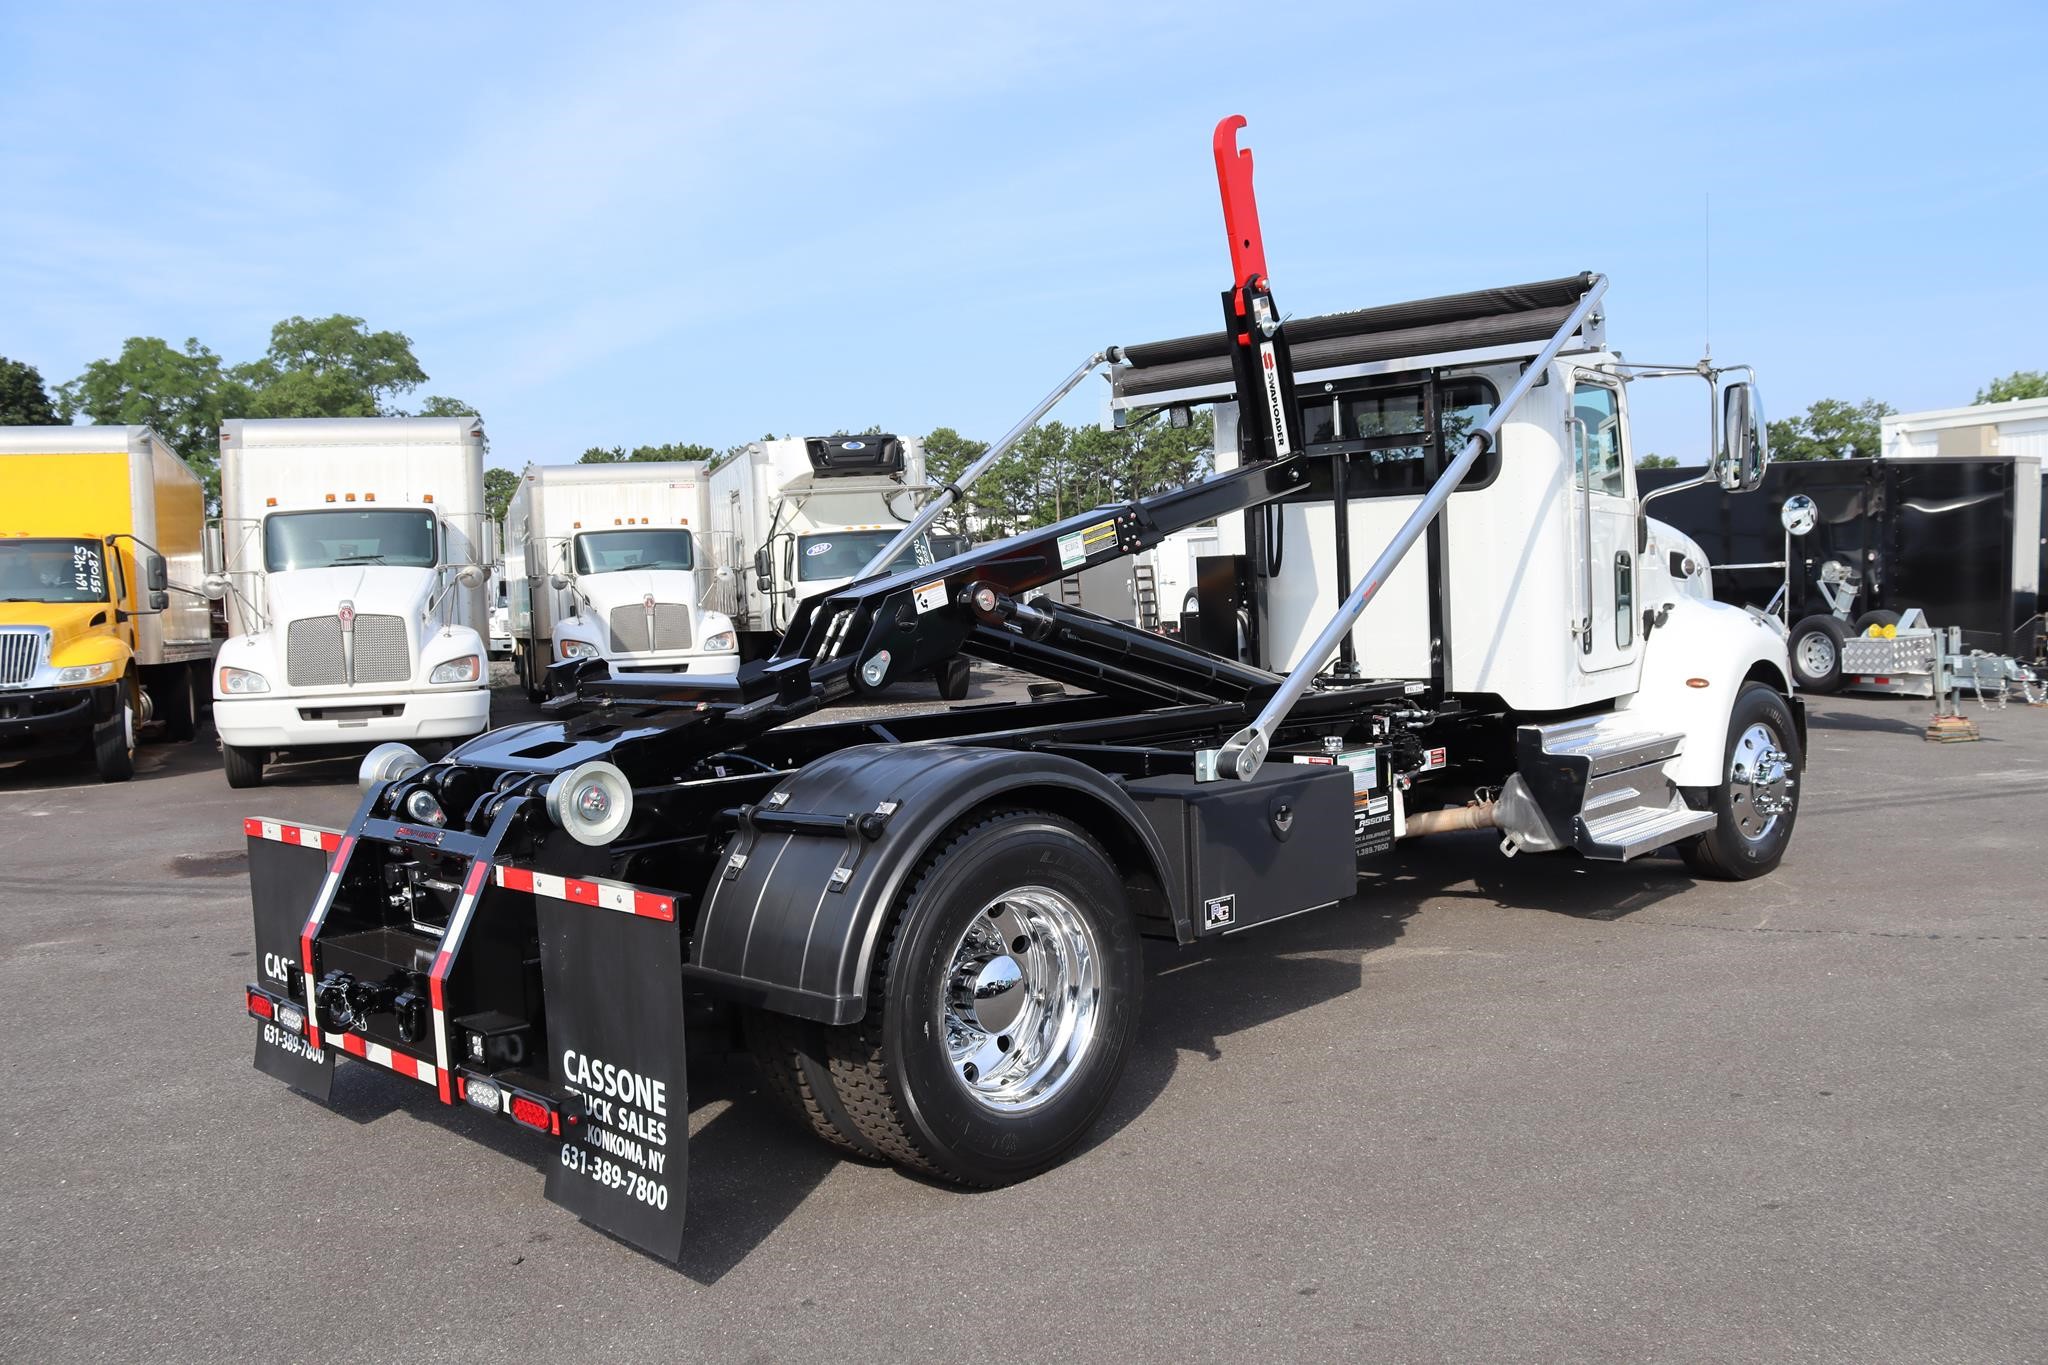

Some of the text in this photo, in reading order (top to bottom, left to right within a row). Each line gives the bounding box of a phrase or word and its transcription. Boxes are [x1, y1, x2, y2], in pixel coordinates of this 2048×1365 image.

[1267, 372, 1285, 446] SWAPLOADER
[87, 550, 102, 593] 551087
[1356, 843, 1389, 857] 1.389.7800
[563, 1049, 667, 1117] CASSONE
[564, 1085, 667, 1146] UCK SALES
[561, 1143, 669, 1211] 631-389-7800
[584, 1124, 666, 1174] KONKOMA, NY
